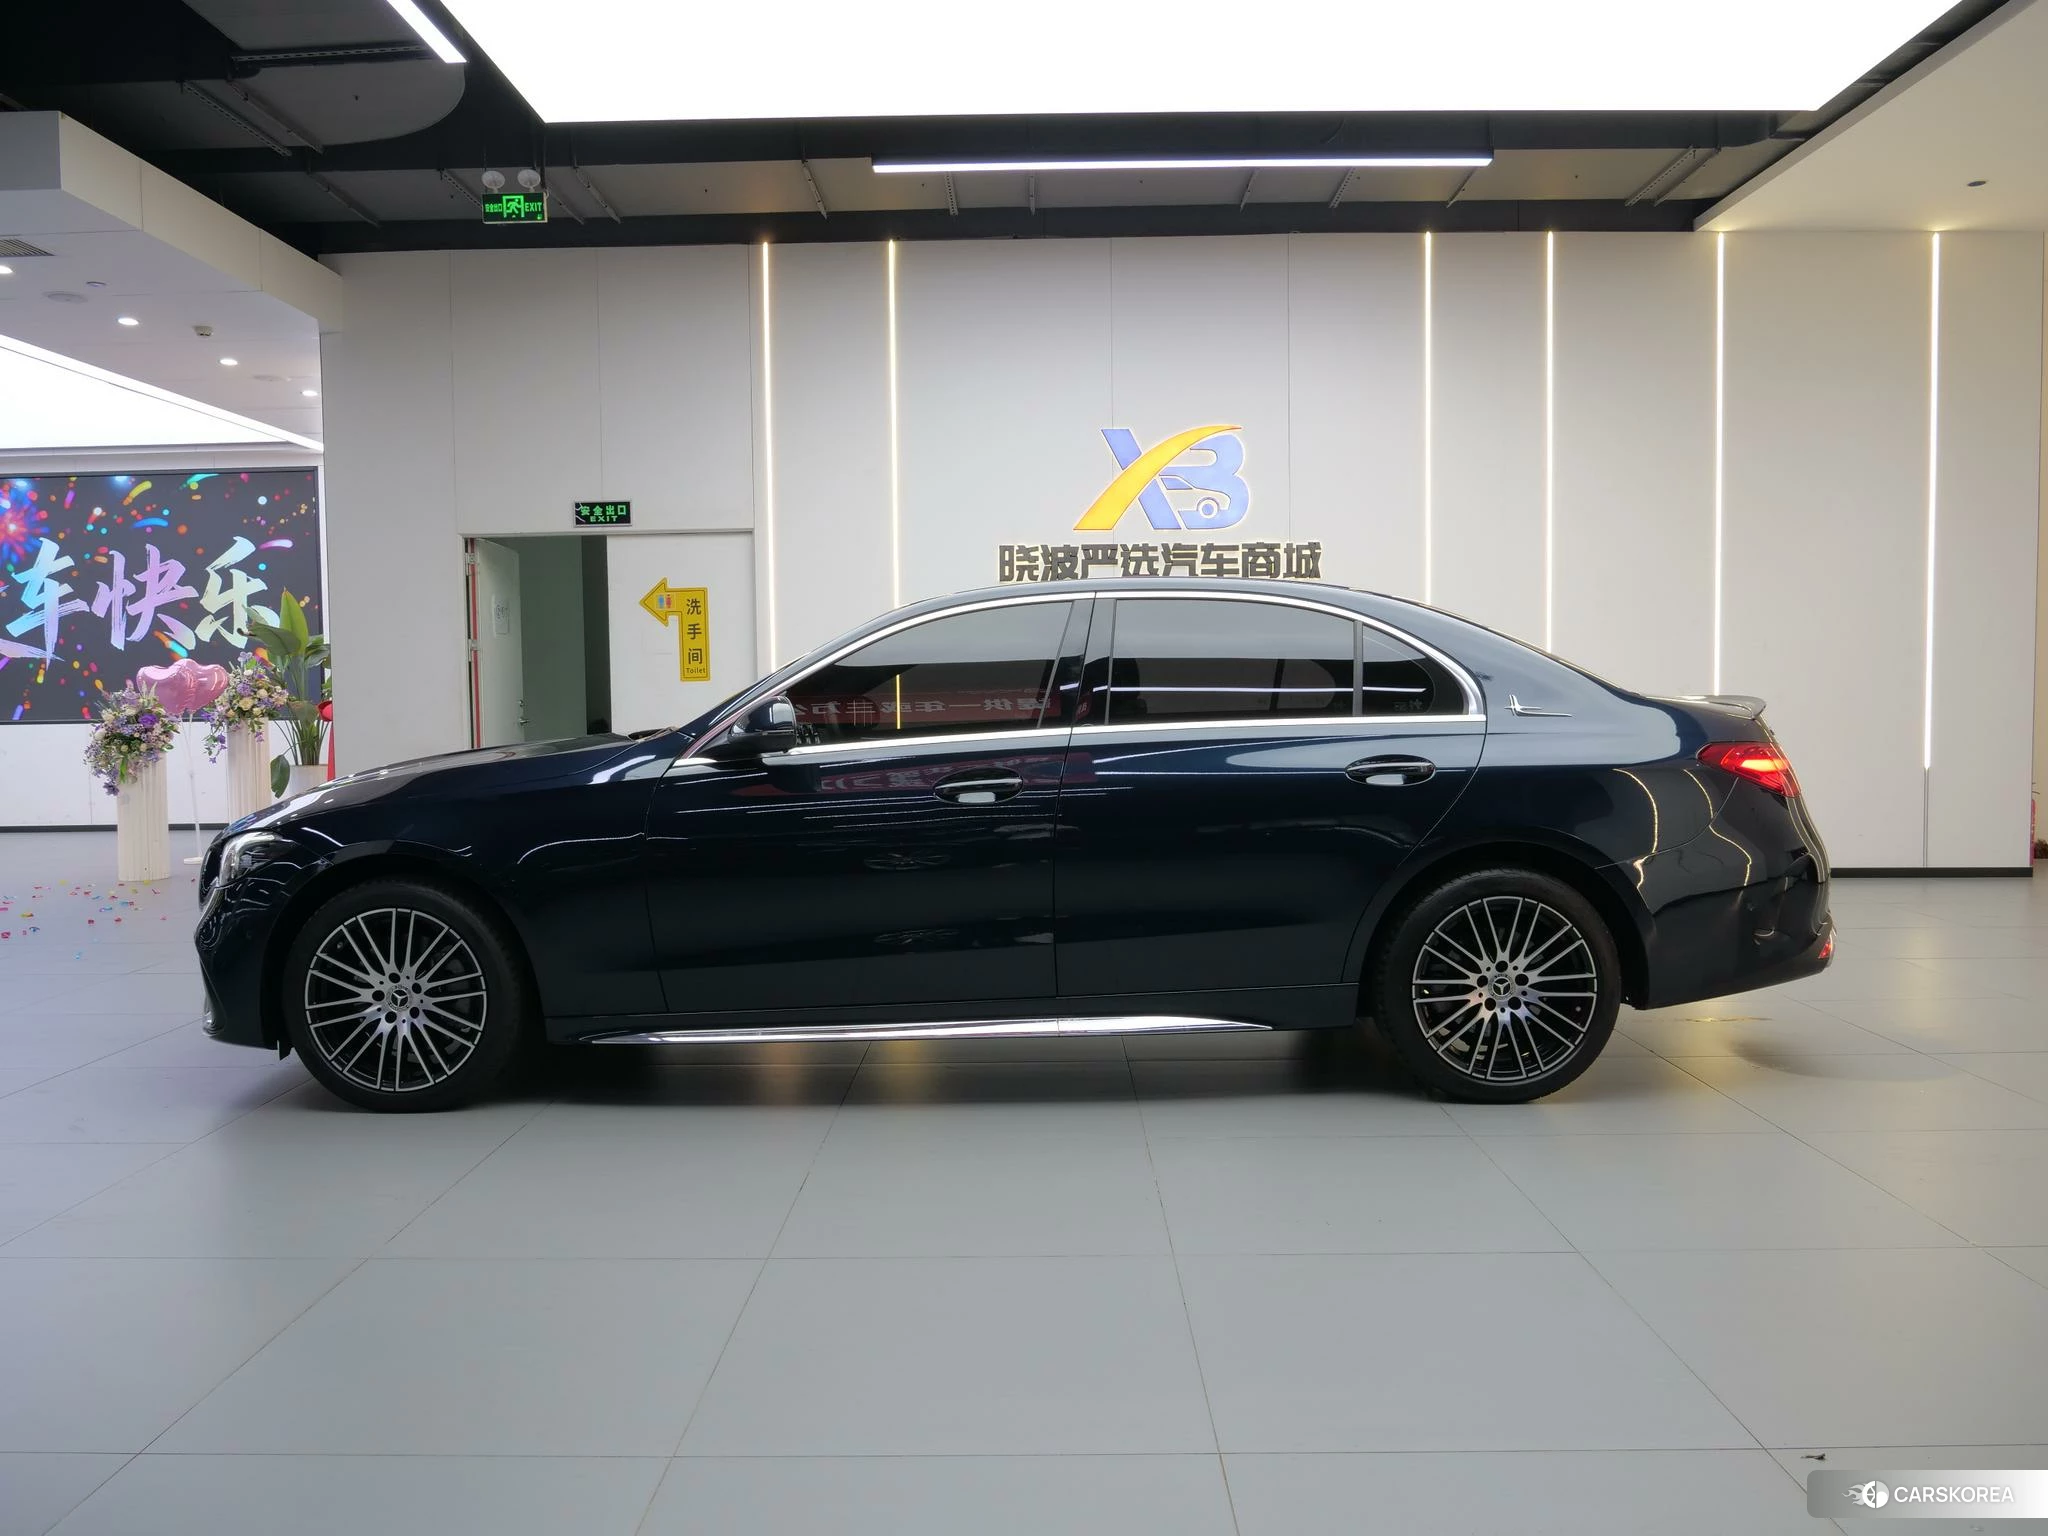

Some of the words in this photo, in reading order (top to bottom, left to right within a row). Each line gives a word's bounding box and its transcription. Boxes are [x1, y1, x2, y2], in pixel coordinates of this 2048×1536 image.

[525, 202, 542, 212] EXIT
[580, 505, 627, 516] 安全出口
[998, 541, 1322, 582] 晓波严选汽车商城
[686, 598, 703, 665] 洗手间
